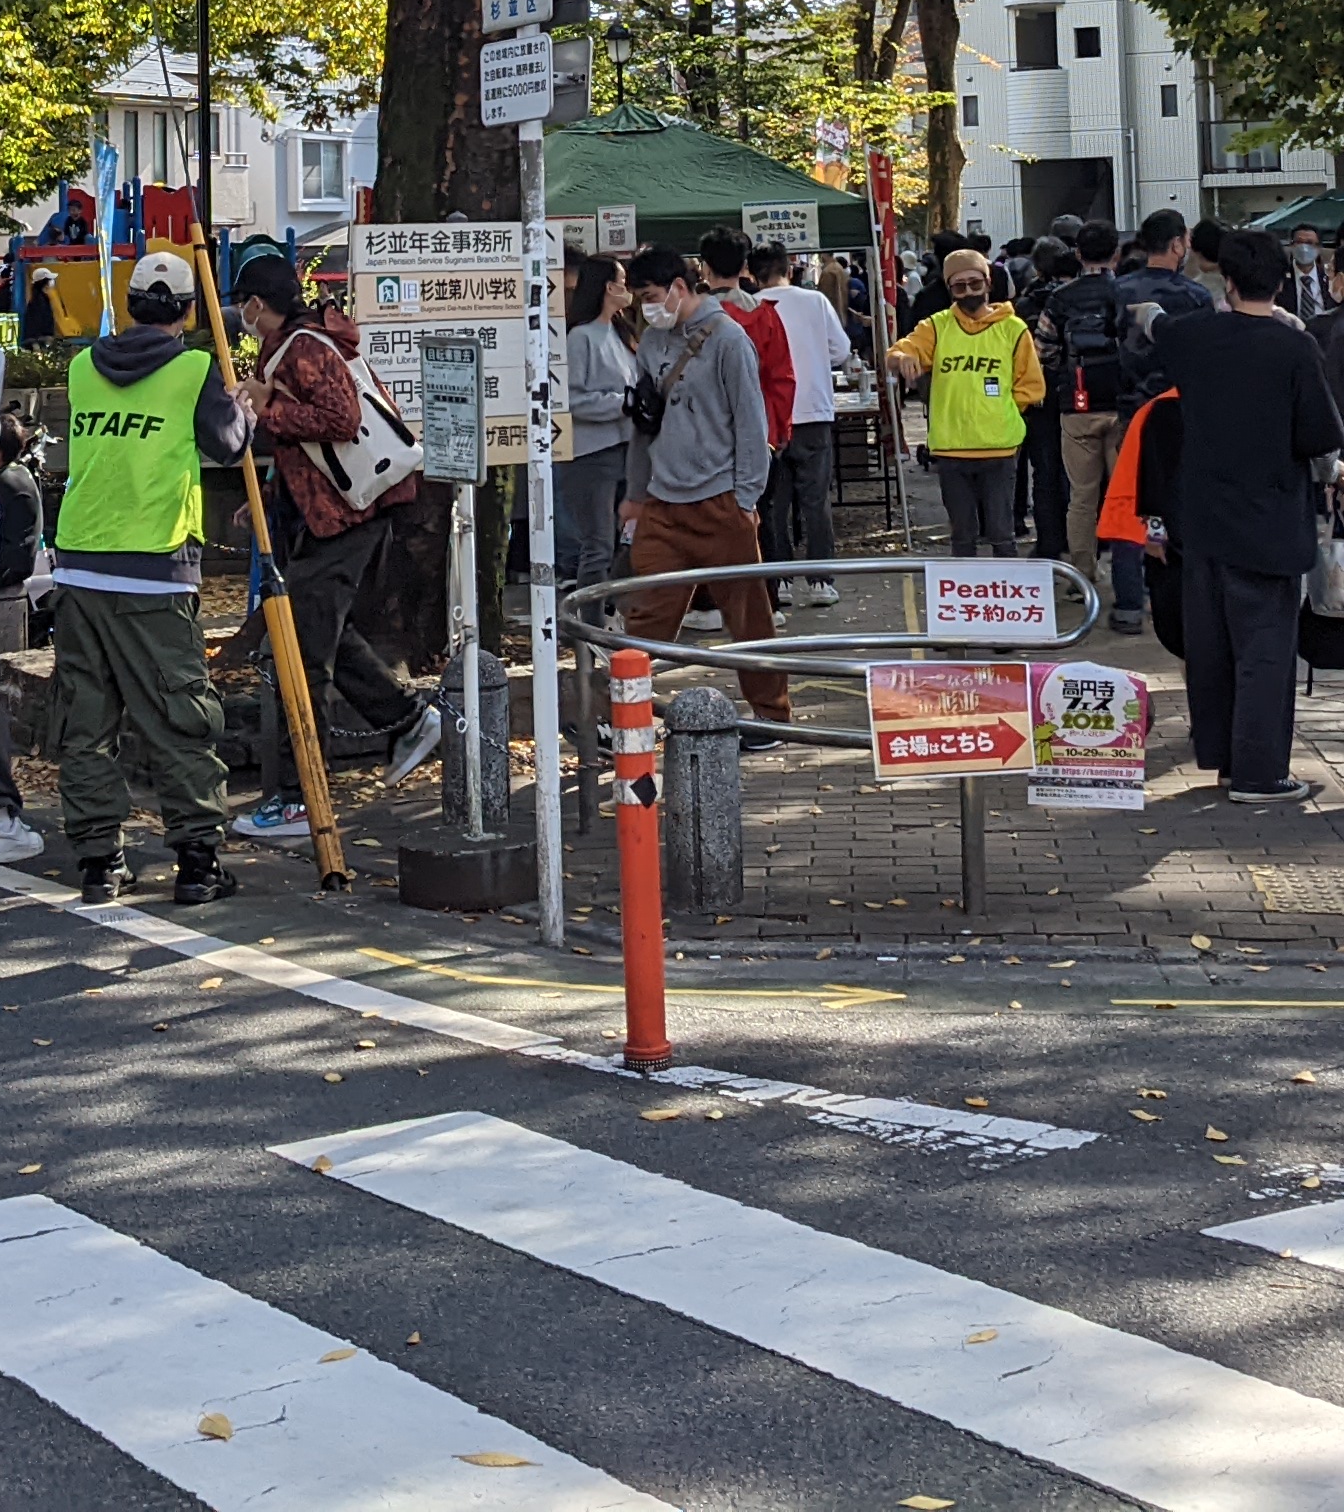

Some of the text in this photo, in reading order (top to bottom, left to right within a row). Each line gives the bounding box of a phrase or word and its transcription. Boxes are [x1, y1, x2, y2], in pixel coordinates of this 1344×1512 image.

[365, 229, 513, 255] 杉並年金事務所
[365, 258, 387, 267] Japan
[388, 257, 415, 265] Pension
[417, 256, 443, 264] Service
[444, 255, 476, 266] Suginami
[477, 255, 500, 263] Branch
[396, 356, 420, 365] Librar
[940, 355, 1002, 374] STAFF
[72, 411, 166, 440] STAFF
[937, 603, 1045, 623] ご予約の方
[1062, 679, 1115, 697] 高円寺
[1062, 696, 1115, 711] フェス
[1060, 712, 1115, 730] 2022
[889, 731, 995, 758] 会場はこちら
